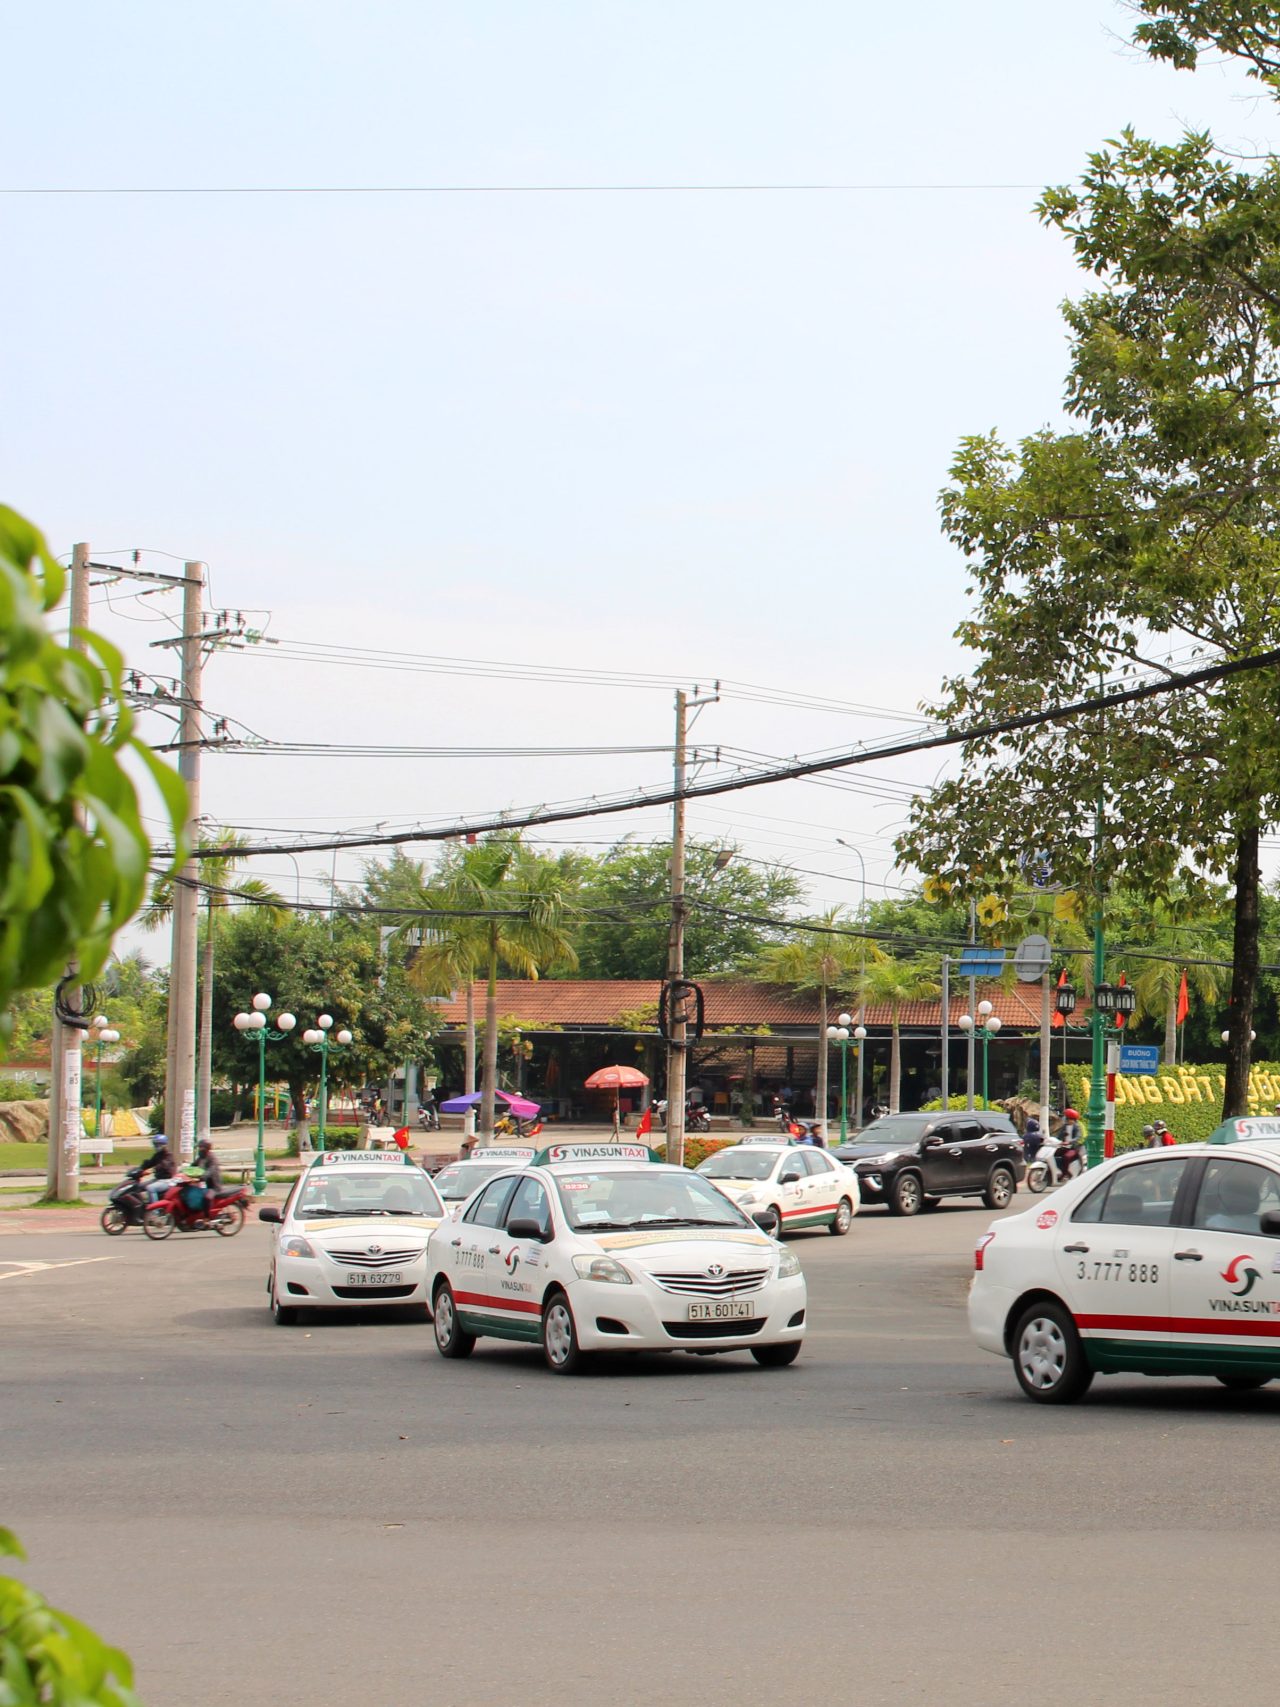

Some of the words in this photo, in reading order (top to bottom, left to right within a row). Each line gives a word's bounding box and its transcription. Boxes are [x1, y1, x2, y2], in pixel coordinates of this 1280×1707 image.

[1081, 1072, 1163, 1105] NG
[341, 1153, 401, 1161] VINASUNTAXI
[572, 1147, 645, 1158] VINASUNTAXI
[1077, 1261, 1123, 1281] 3.777
[1129, 1264, 1159, 1283] 888
